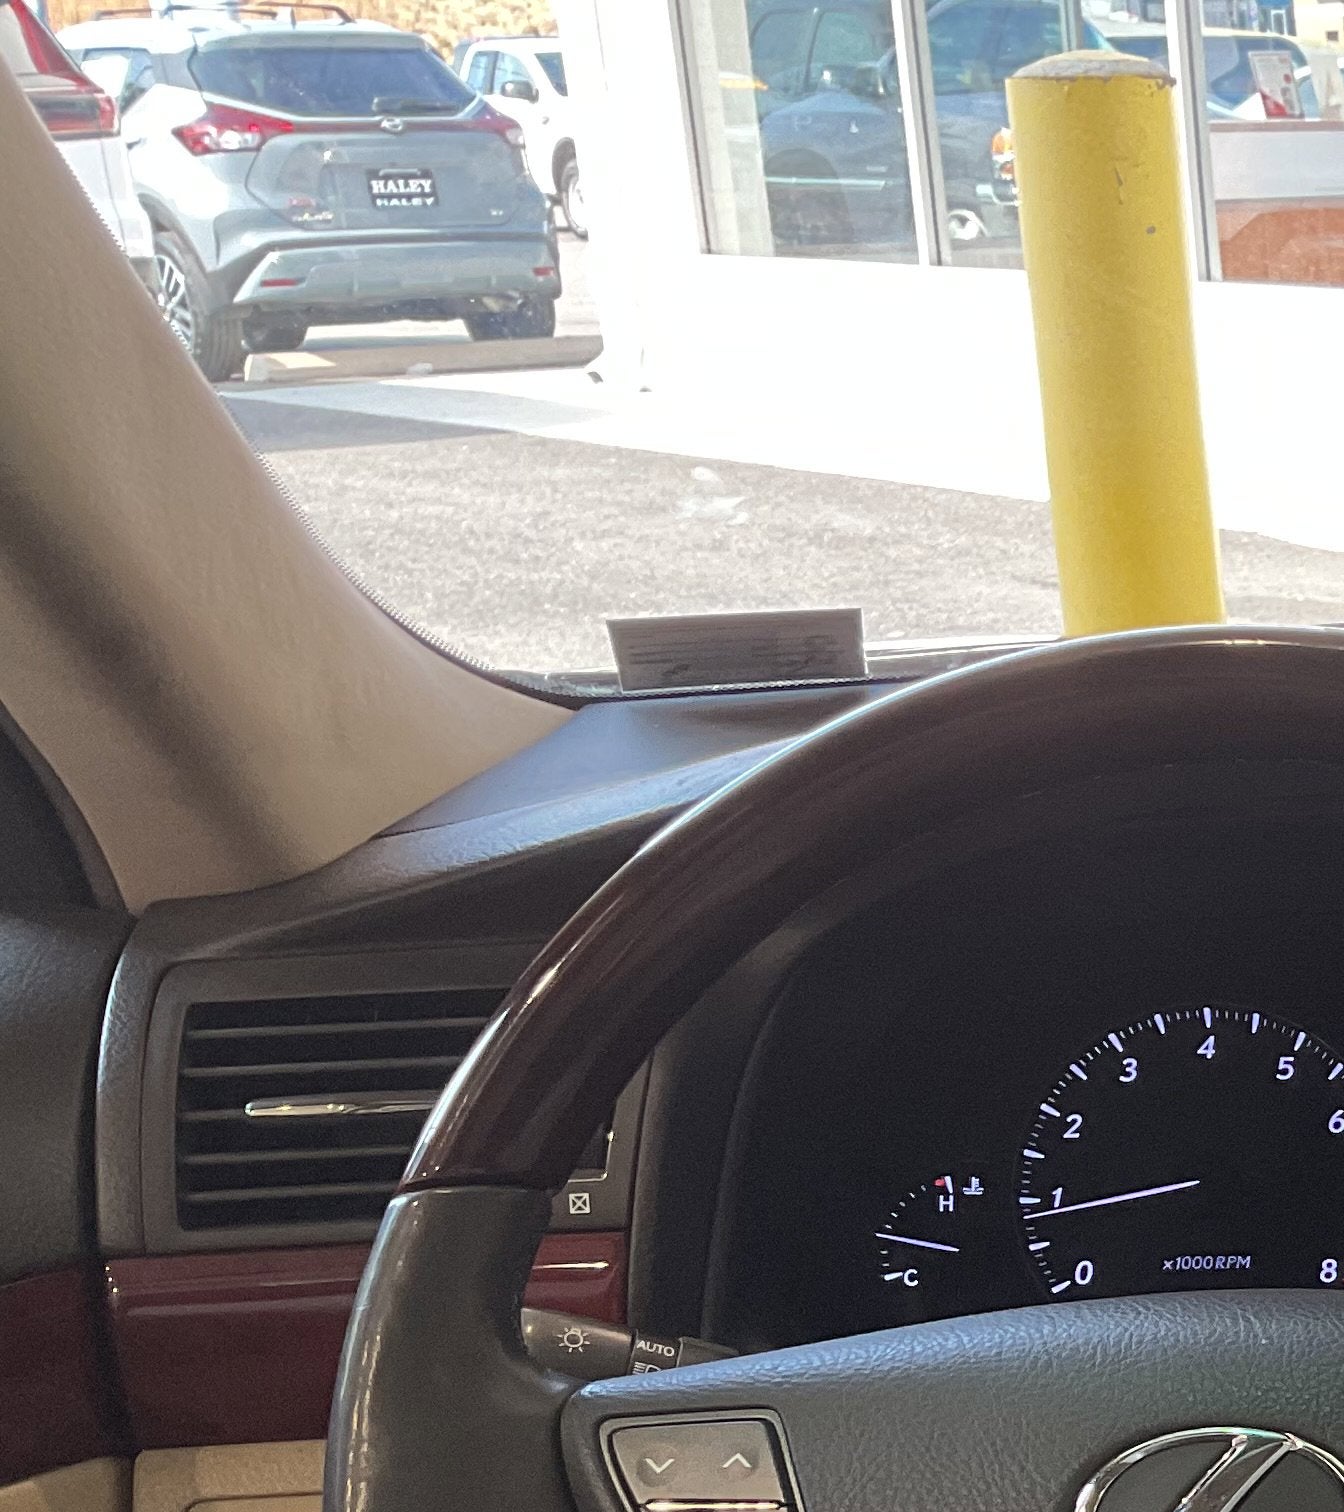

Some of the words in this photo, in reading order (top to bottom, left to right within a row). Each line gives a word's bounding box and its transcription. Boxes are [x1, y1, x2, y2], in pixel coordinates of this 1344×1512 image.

[370, 179, 432, 194] HALEY
[1196, 1034, 1216, 1059] 4
[1118, 1057, 1139, 1083] 3
[1275, 1056, 1295, 1081] 5
[1062, 1113, 1083, 1139] 2
[938, 1194, 954, 1213] H
[1051, 1186, 1063, 1208] 1
[903, 1268, 919, 1287] C
[1074, 1260, 1094, 1286] 0
[1319, 1258, 1338, 1284] 8
[636, 1338, 676, 1357] AUTO
